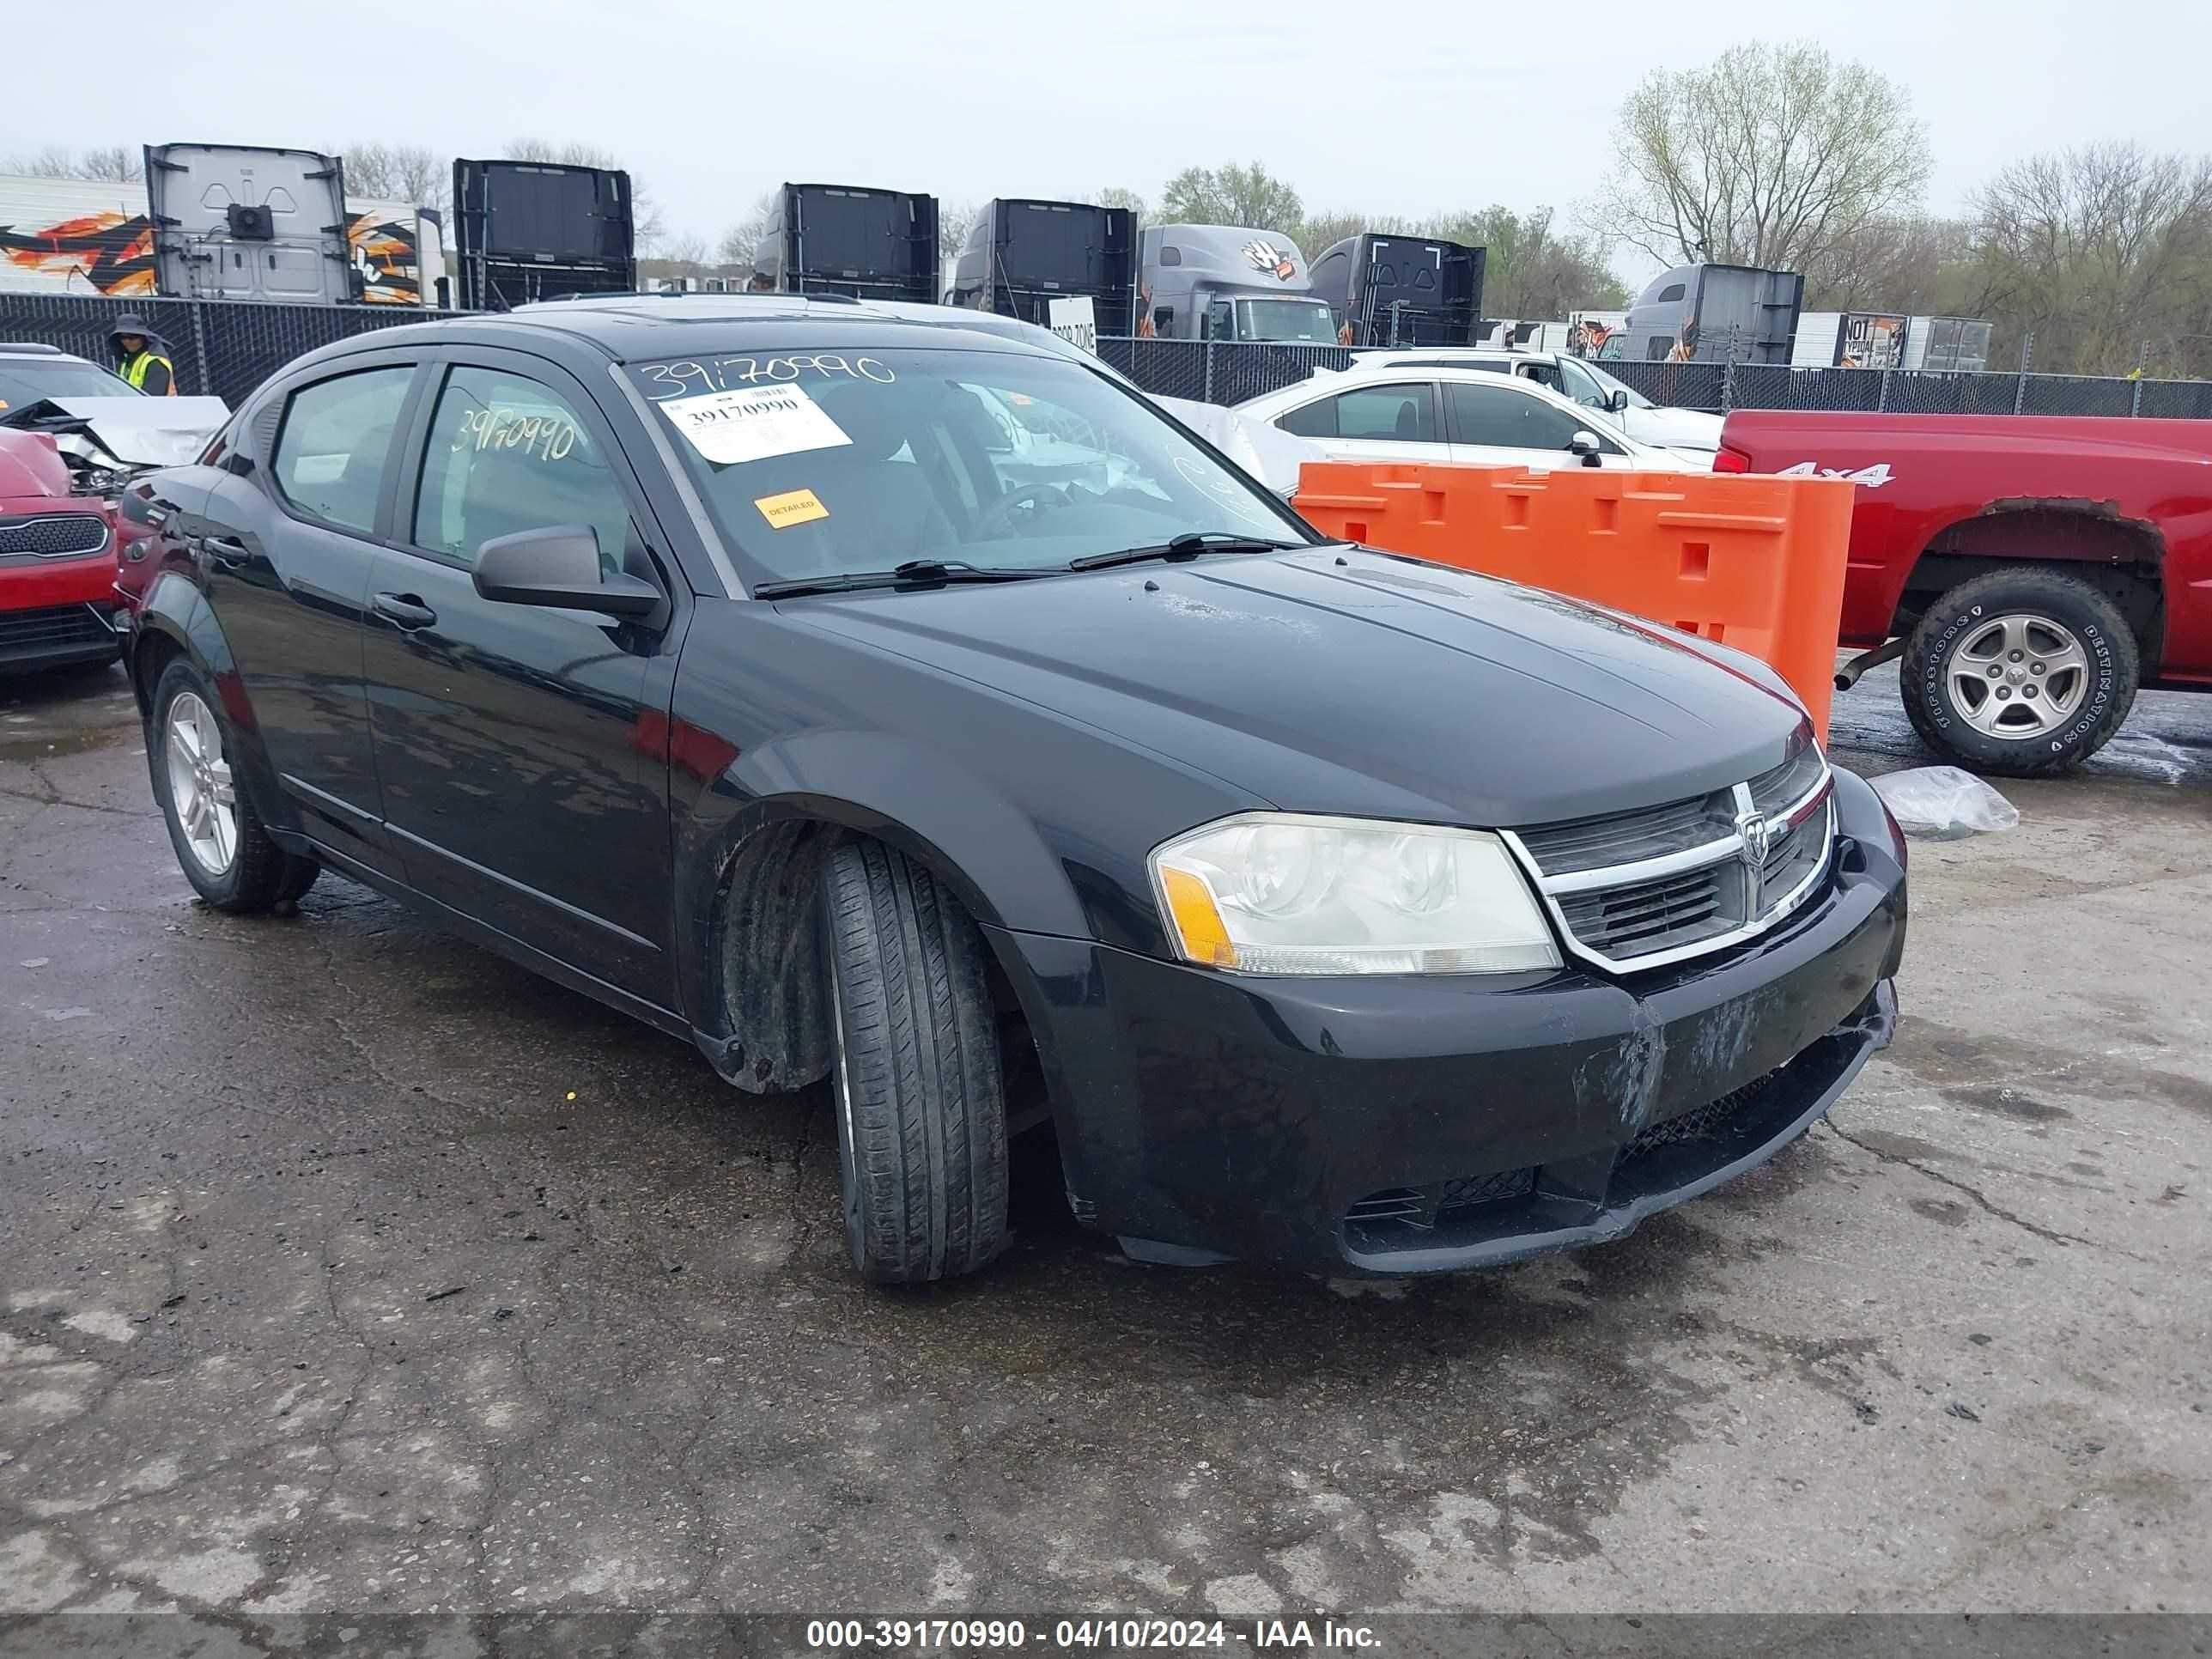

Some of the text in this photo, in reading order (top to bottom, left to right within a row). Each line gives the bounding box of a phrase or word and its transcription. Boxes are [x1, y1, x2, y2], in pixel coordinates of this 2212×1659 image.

[1074, 322, 1095, 349] ZONE
[1846, 319, 1869, 341] NOT
[1843, 340, 1875, 353] TYPICAL
[641, 355, 896, 401] 39170990
[687, 397, 799, 426] 39170990
[1775, 461, 1897, 488] 4x4
[768, 500, 816, 517] DETAILED
[1926, 615, 1970, 730] Firestone
[2063, 623, 2113, 744] DESTINATION
